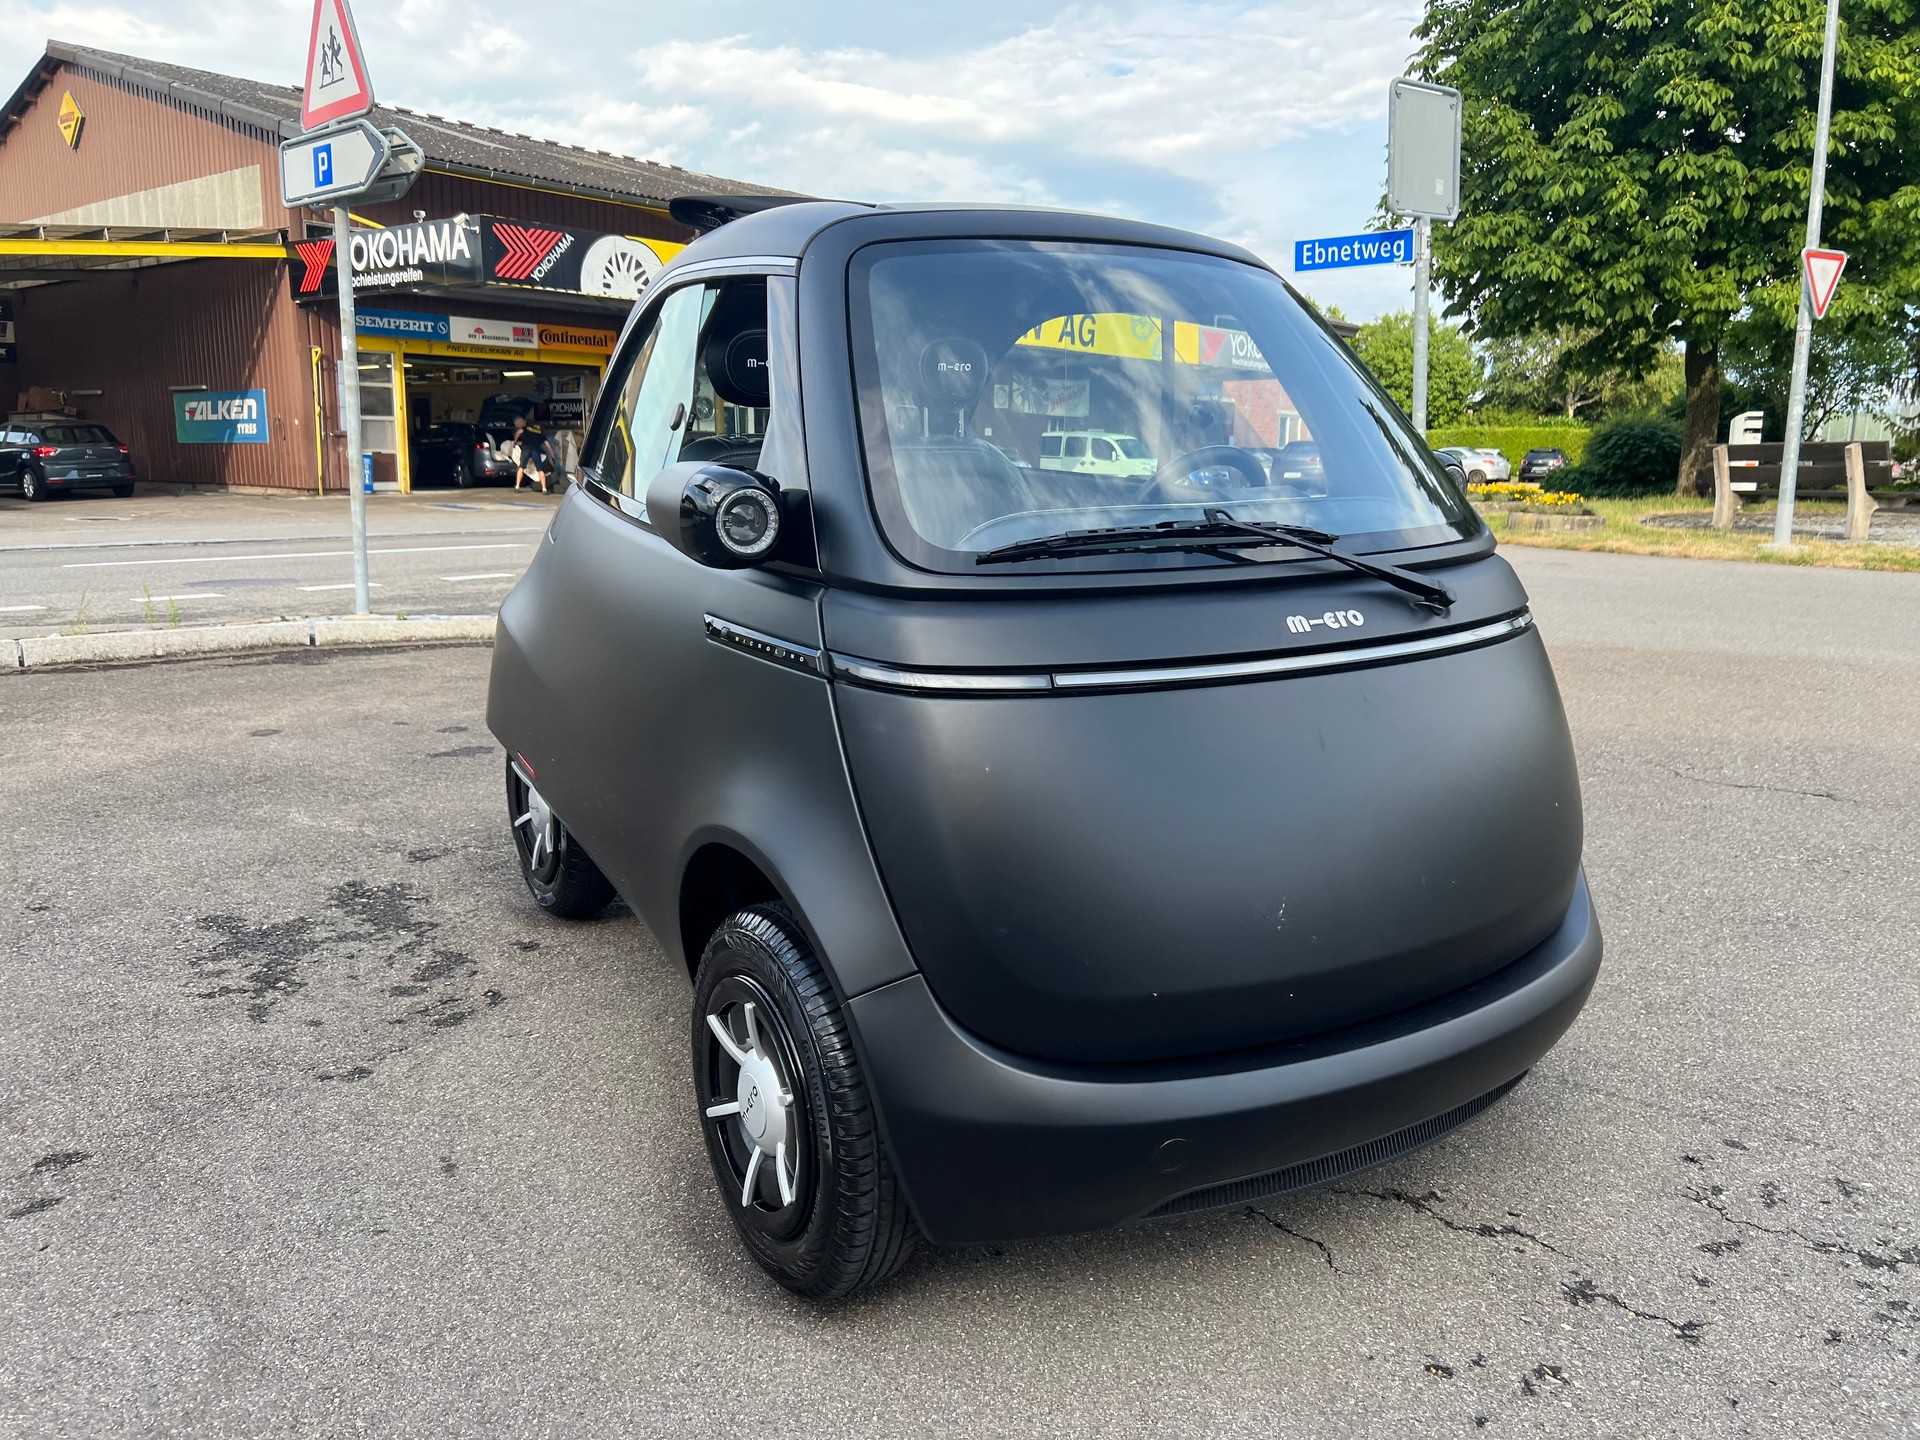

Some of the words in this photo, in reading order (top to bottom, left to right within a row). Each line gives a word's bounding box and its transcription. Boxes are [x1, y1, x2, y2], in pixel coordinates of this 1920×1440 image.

[317, 151, 329, 182] P
[350, 223, 470, 271] OKOHAMA
[530, 232, 575, 281] YOKOHAMA
[1302, 239, 1405, 265] Ebnetweg
[352, 268, 423, 287] ochleistungsreifen
[355, 315, 434, 333] SEMPERIT
[1058, 314, 1097, 347] AG
[446, 344, 467, 353] PNEU
[538, 328, 608, 347] Continental
[184, 398, 257, 421] FALKEN
[236, 422, 257, 435] TYRES
[735, 636, 805, 663] MICROLINO
